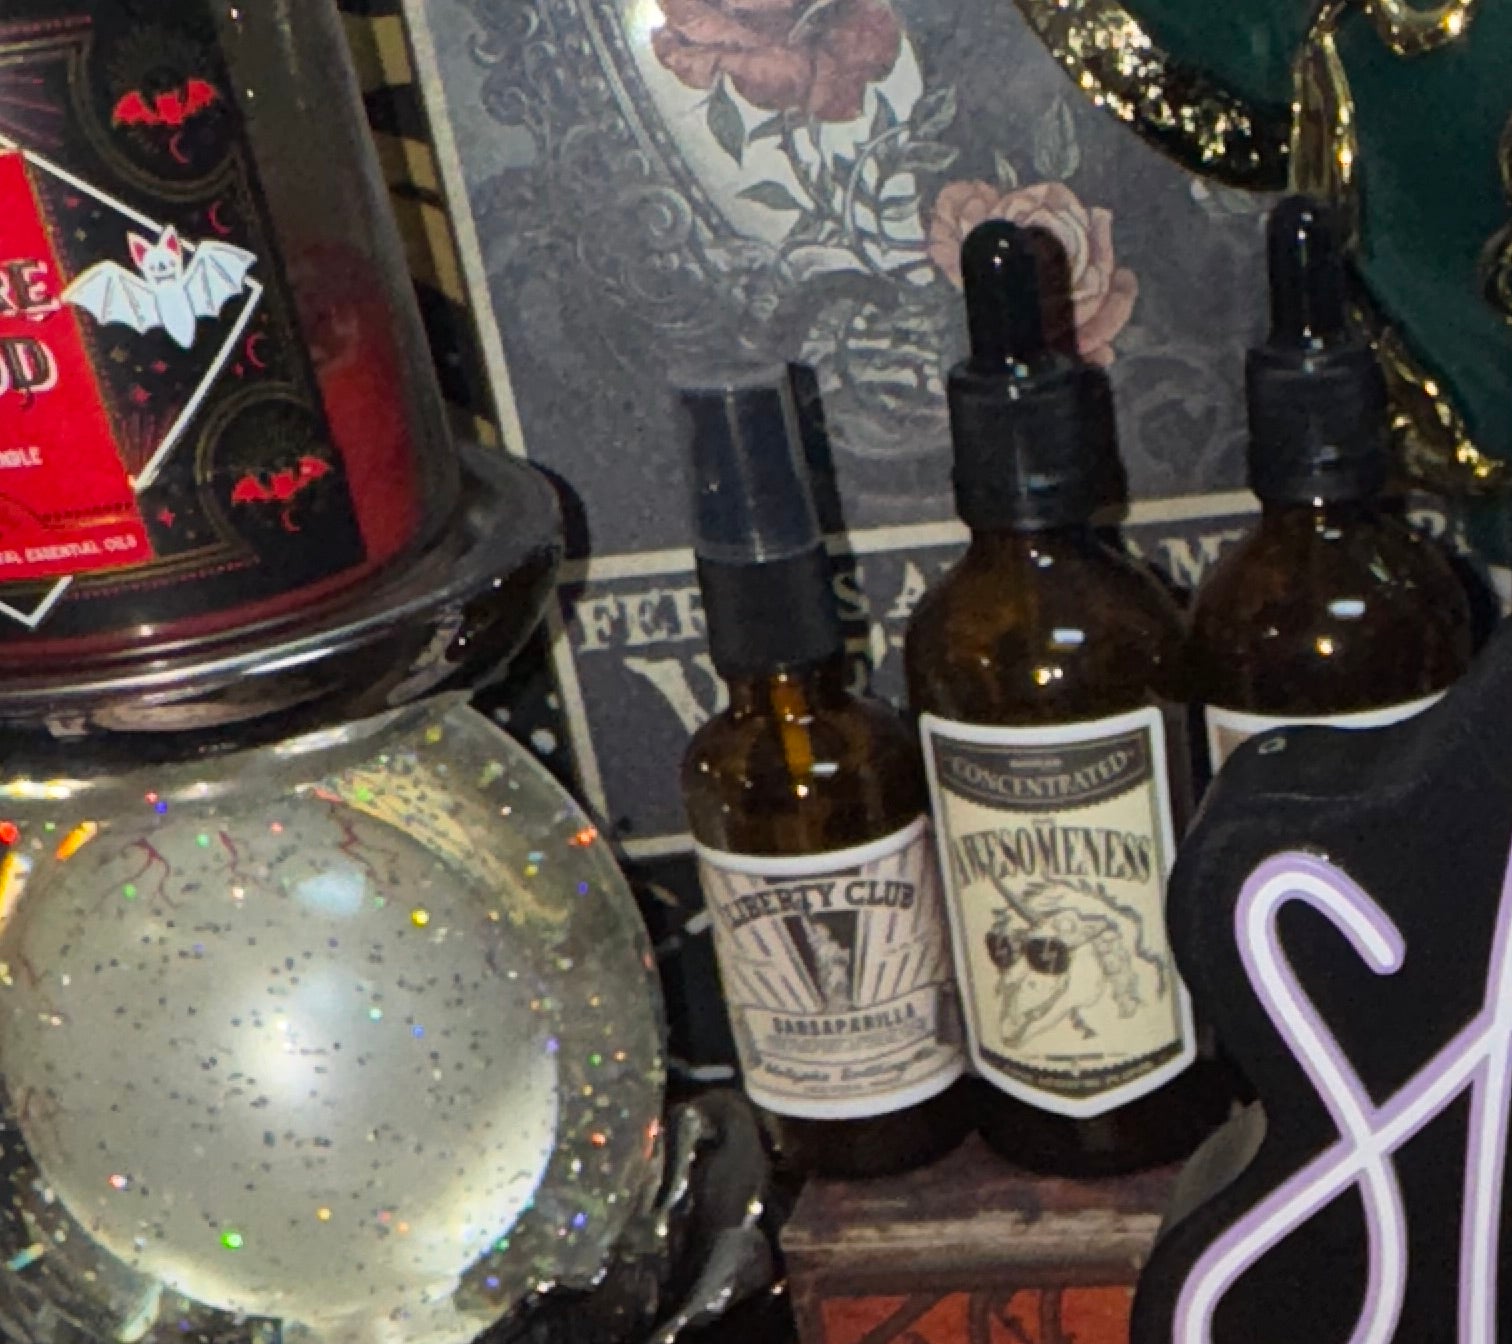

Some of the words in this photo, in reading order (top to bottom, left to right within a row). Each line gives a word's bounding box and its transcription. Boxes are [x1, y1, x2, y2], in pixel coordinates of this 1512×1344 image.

[953, 750, 1130, 797] CONCENTRATED
[952, 817, 1153, 886] AWESOMENESS
[720, 881, 836, 929] LIBERTY
[844, 879, 915, 910] CLUB
